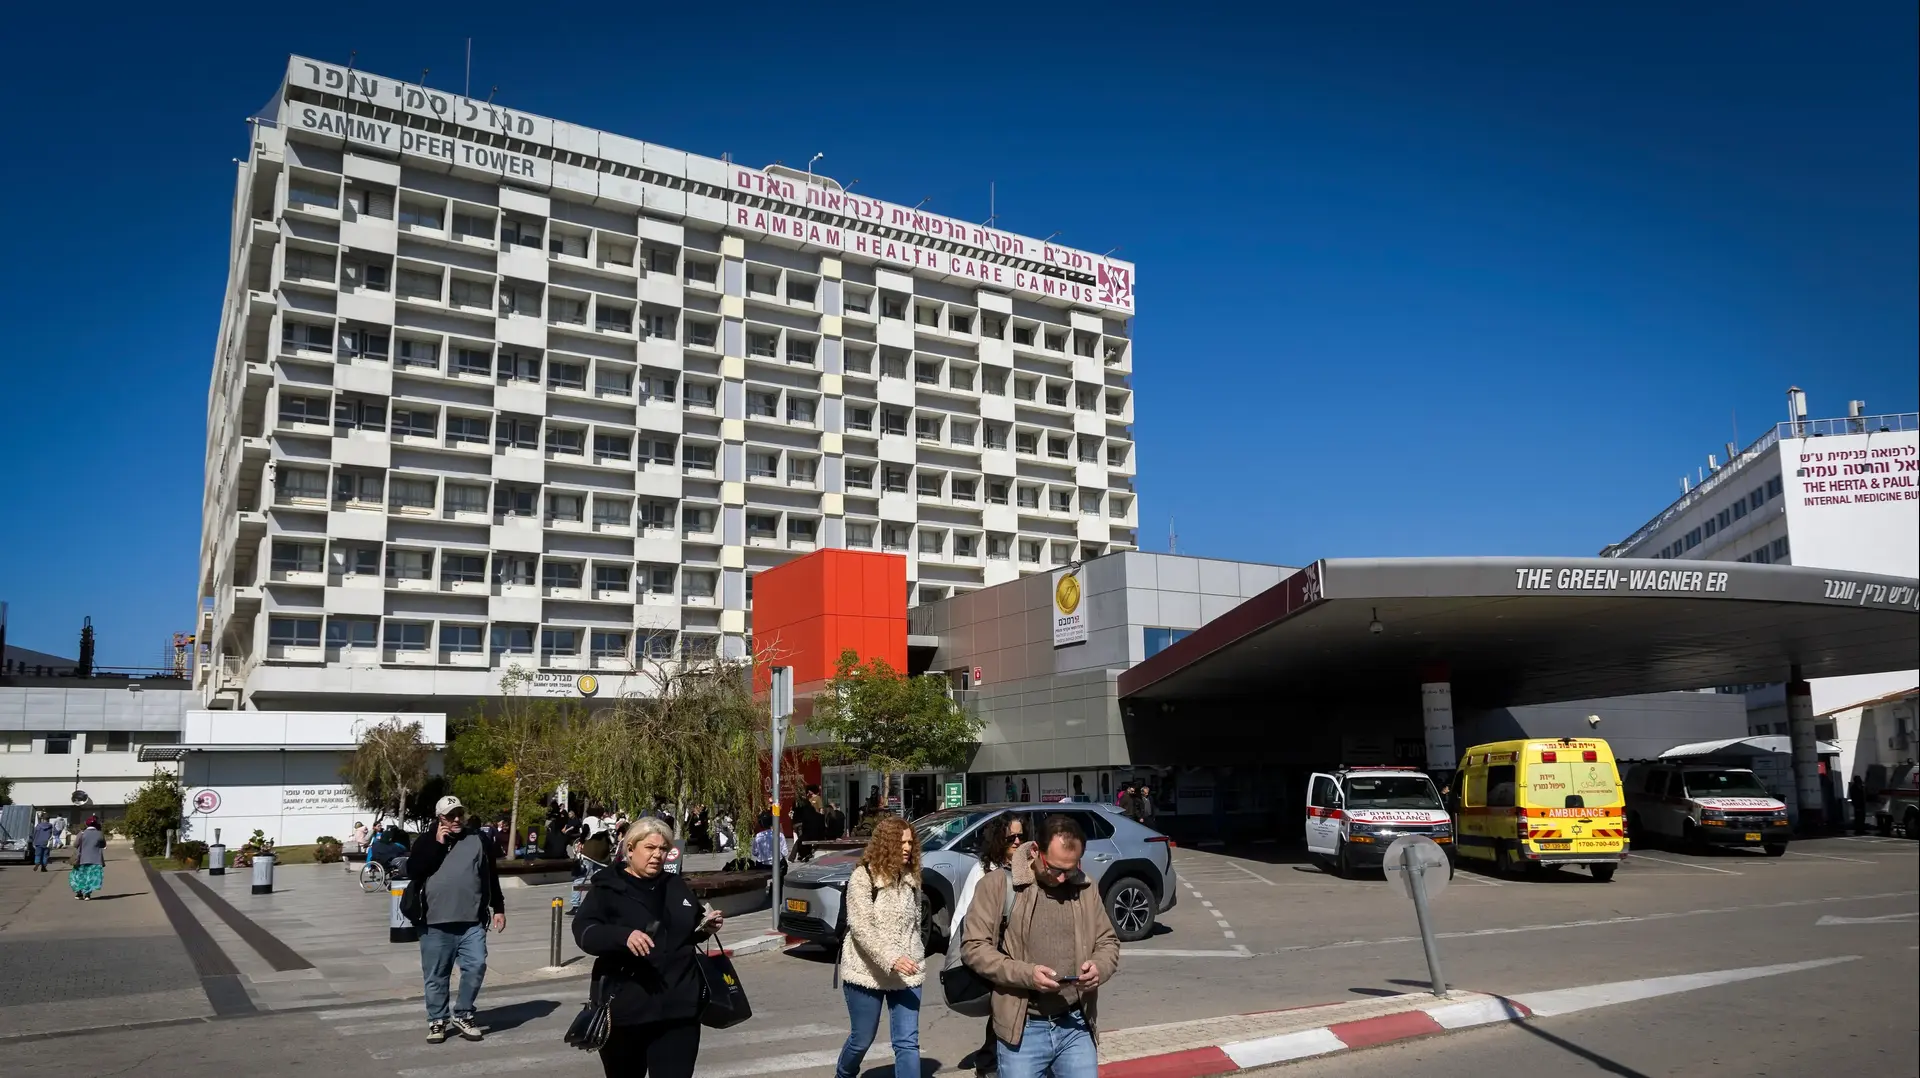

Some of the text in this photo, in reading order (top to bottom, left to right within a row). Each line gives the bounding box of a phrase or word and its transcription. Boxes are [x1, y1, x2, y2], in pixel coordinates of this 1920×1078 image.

[304, 63, 535, 136] מגדל סמי עופר
[302, 108, 535, 178] SAMMY OFER TOWER
[738, 170, 795, 200] האדם
[806, 186, 884, 220] לבריאות
[892, 207, 966, 241] הרפואית
[973, 228, 1024, 255] הקריה
[738, 208, 1093, 302] RAMBAM HEALTH CARE CAMPUS
[1828, 450, 1867, 461] פנימית
[1871, 444, 1916, 458] לרפואה
[1803, 465, 1837, 477] עמיר
[1803, 476, 1915, 493] THE HERTA & PAUL
[1804, 495, 1852, 506] INTERNAL
[1854, 492, 1902, 503] MEDICINE
[1516, 568, 1728, 592] THE GREEN-WAGNER ER
[535, 673, 550, 681] סמי
[552, 673, 572, 681] מגדל
[584, 679, 590, 689] 1
[1549, 808, 1604, 817] AMBULANCE
